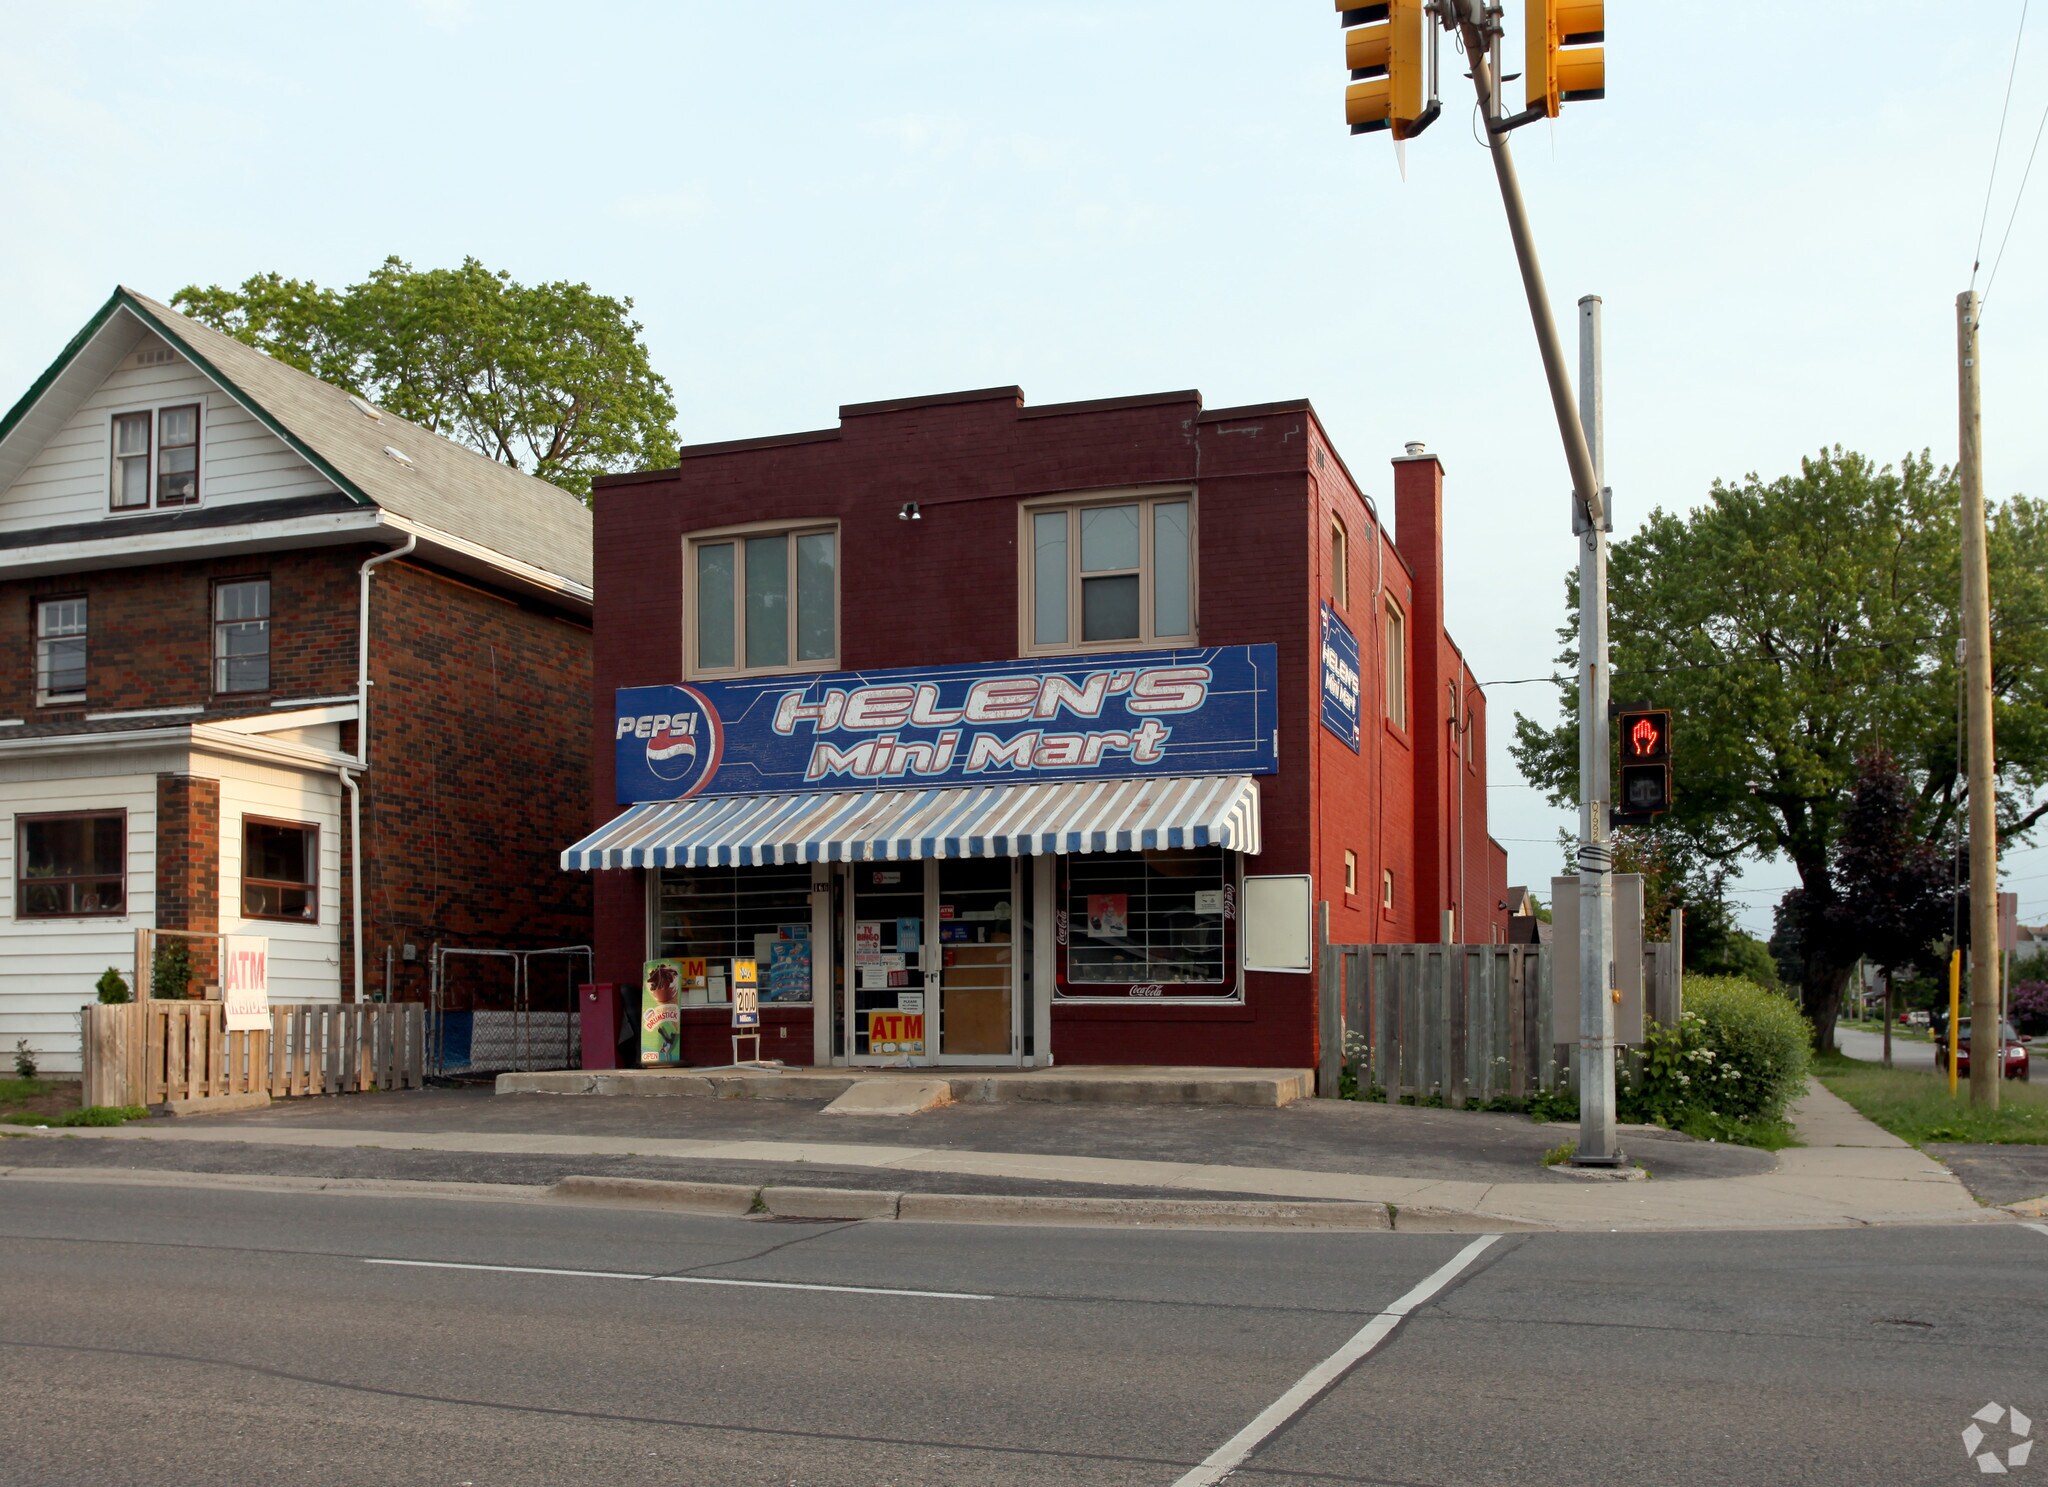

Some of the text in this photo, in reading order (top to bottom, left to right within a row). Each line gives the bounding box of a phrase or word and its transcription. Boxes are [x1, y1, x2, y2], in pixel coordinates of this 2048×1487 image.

[1322, 641, 1359, 696] HELEN'S
[773, 665, 1212, 736] HELEN'S
[616, 712, 698, 740] PEPSI
[804, 718, 1171, 781] Mini Mart
[856, 933, 880, 942] BINGO
[863, 926, 873, 934] TV
[228, 951, 266, 990] ATM
[1129, 984, 1164, 997] Coca-Cola
[228, 997, 268, 1014] INSIDE
[646, 1011, 678, 1029] DRUMSTICK
[871, 1015, 922, 1040] ATM
[643, 1053, 659, 1061] OPEN
